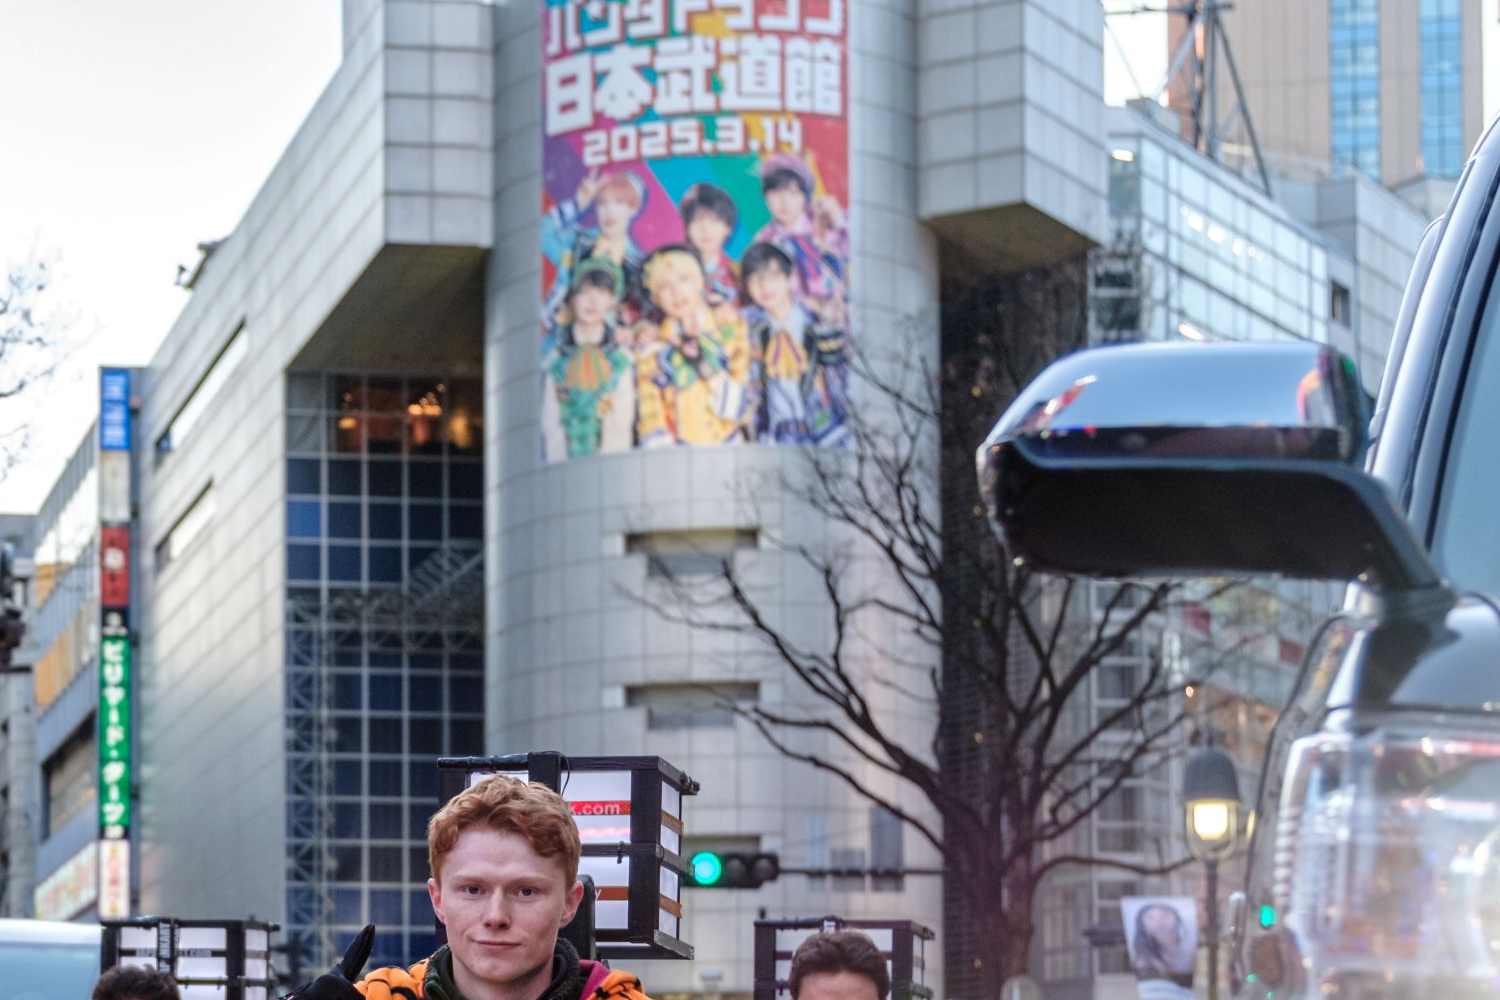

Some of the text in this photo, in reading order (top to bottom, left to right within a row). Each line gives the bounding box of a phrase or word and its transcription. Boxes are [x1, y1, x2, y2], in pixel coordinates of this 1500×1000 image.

[546, 33, 842, 136] 日本武道館
[583, 115, 801, 167] 2025.3.14
